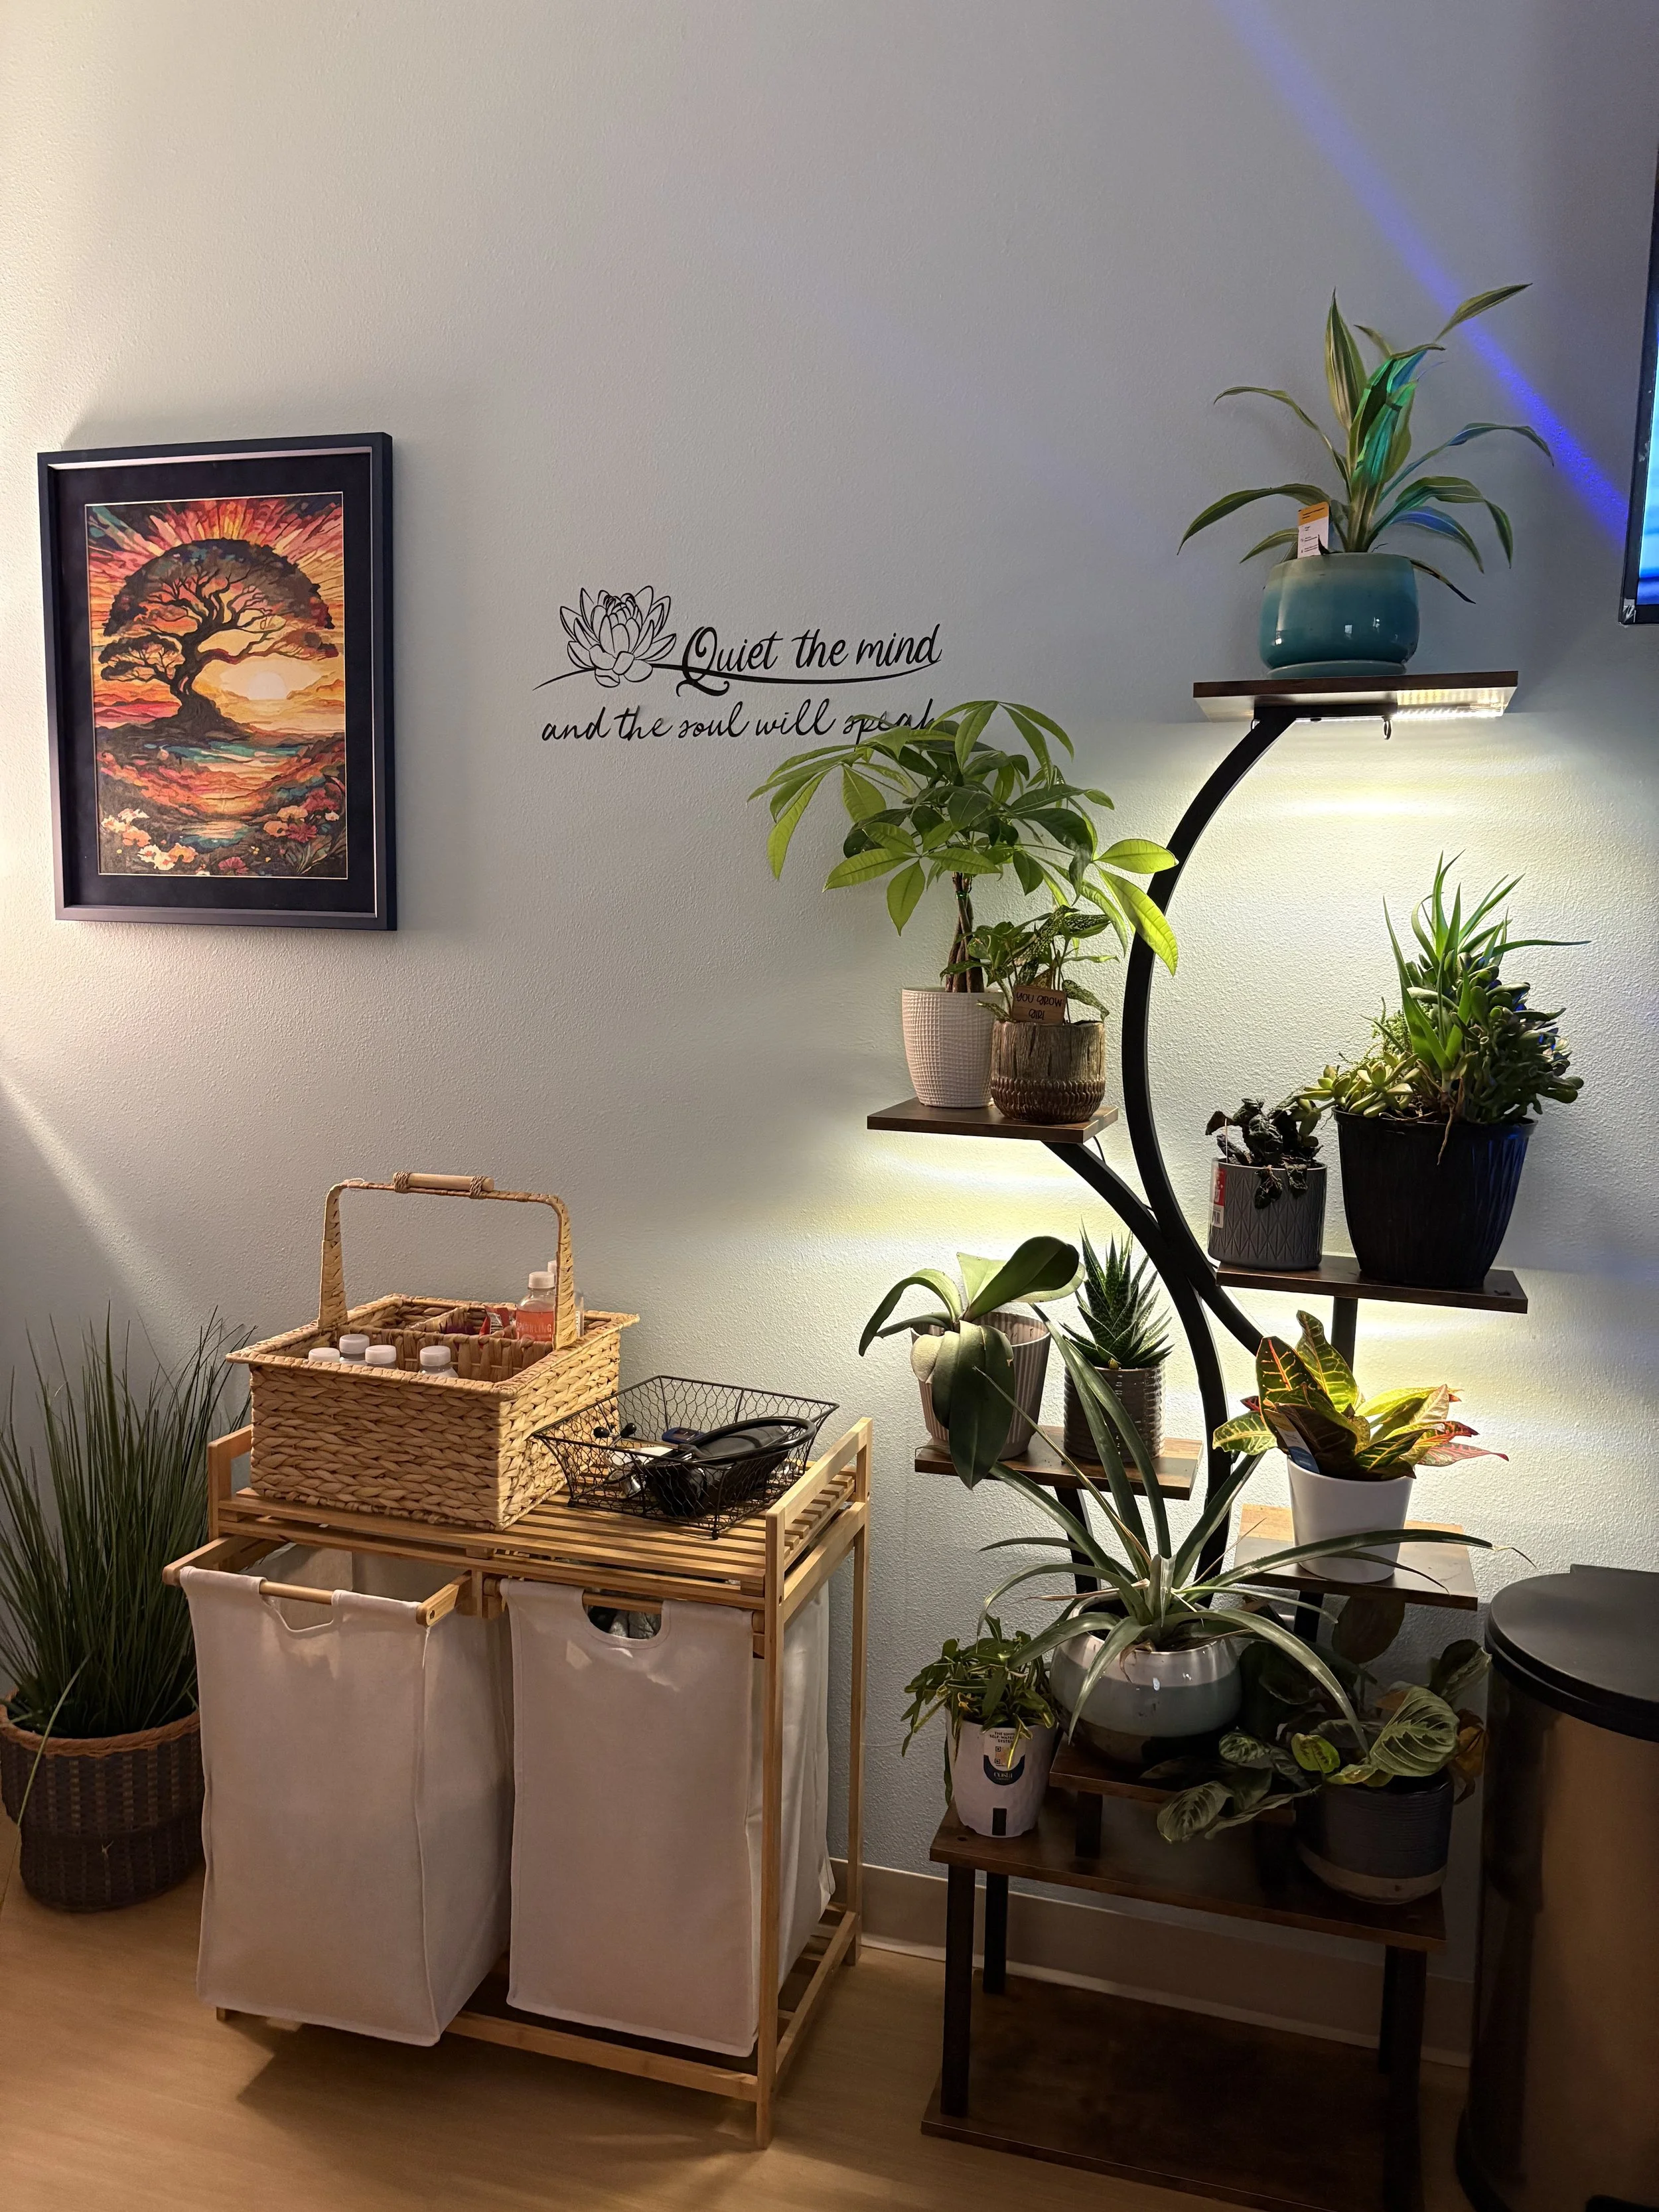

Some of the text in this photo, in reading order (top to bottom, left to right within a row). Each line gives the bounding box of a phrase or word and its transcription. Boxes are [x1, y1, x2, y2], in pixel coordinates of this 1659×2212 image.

[676, 623, 942, 697] Quiet the mind
[541, 705, 611, 741] and
[613, 705, 674, 741] the
[678, 701, 751, 739] soul
[755, 698, 837, 736] will
[1016, 992, 1062, 1007] YOU GROW
[1029, 1008, 1046, 1020] GIRL
